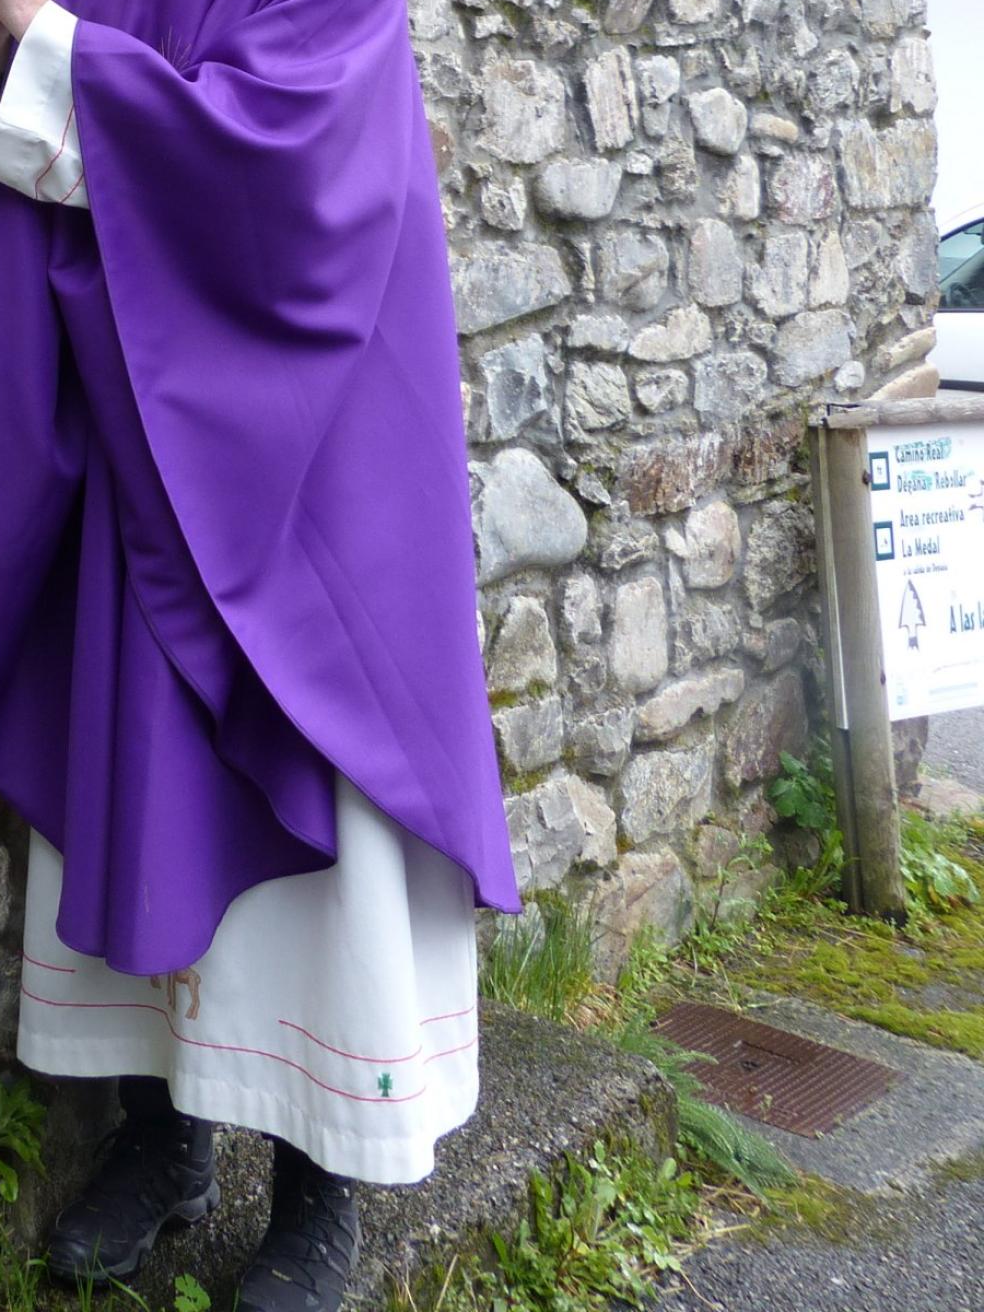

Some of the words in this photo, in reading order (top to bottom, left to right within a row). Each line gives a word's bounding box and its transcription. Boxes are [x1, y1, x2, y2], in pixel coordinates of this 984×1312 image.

[922, 505, 965, 525] recreativa
[902, 538, 913, 558] La
[915, 535, 940, 556] Medal
[959, 603, 975, 633] las
